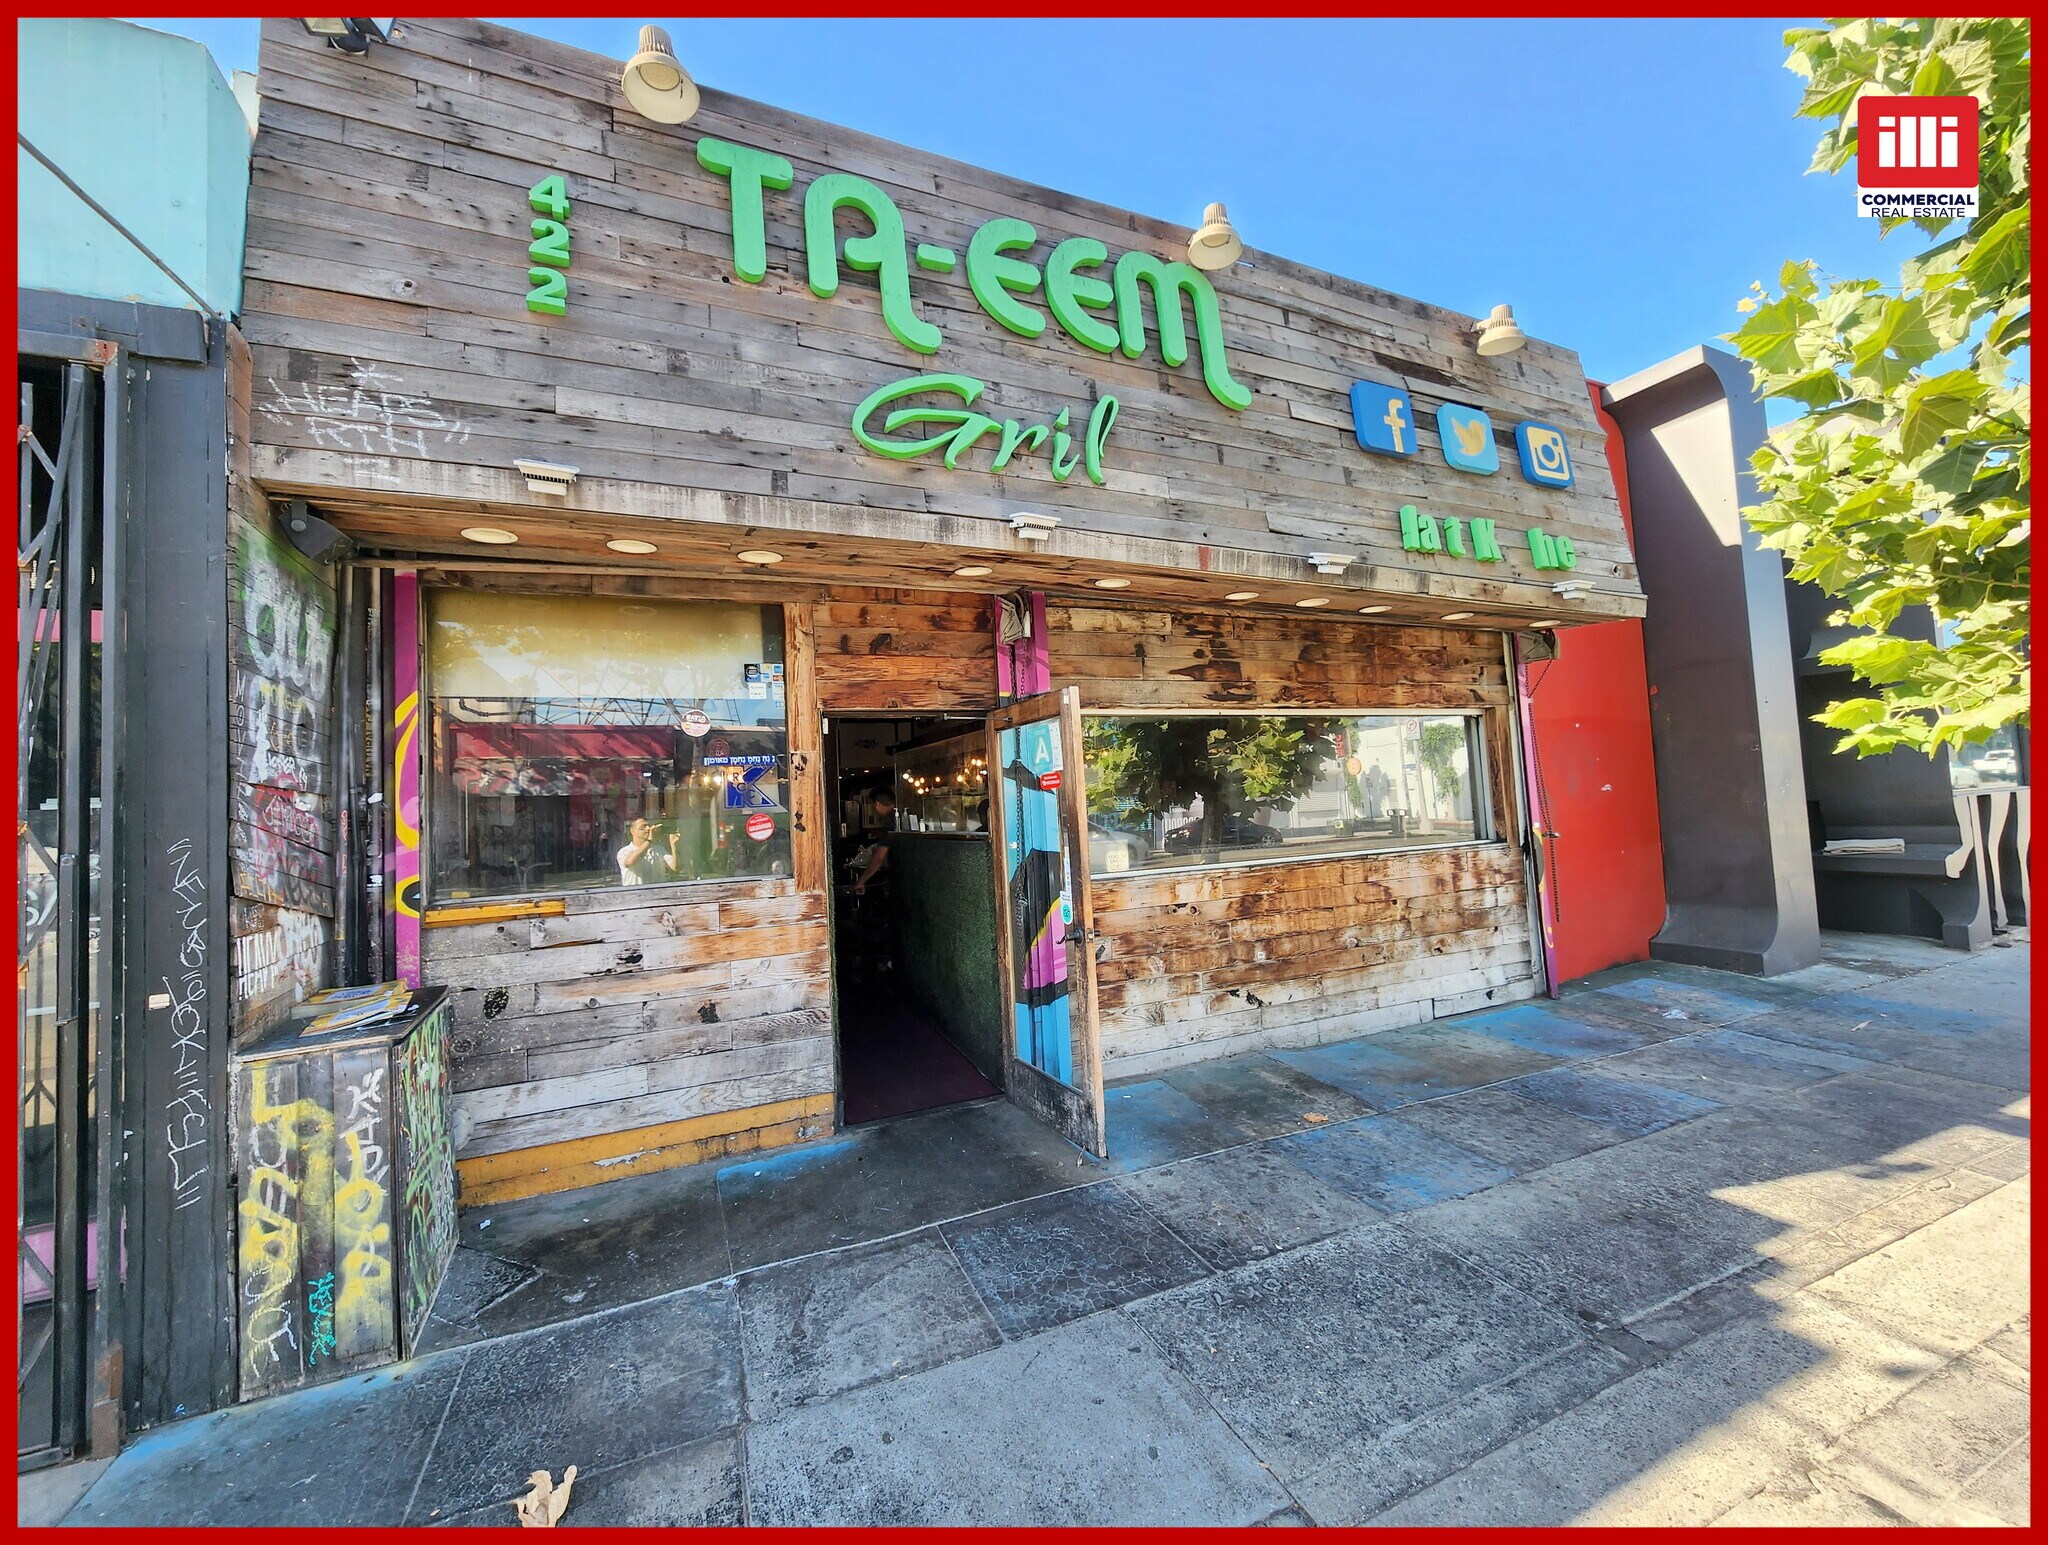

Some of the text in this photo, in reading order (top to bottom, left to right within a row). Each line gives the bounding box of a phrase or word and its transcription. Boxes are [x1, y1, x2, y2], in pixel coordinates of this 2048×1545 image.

[526, 175, 571, 317] 422
[696, 137, 1252, 411] TA-EEM
[852, 373, 1119, 485] Gril
[1035, 736, 1050, 764] A
